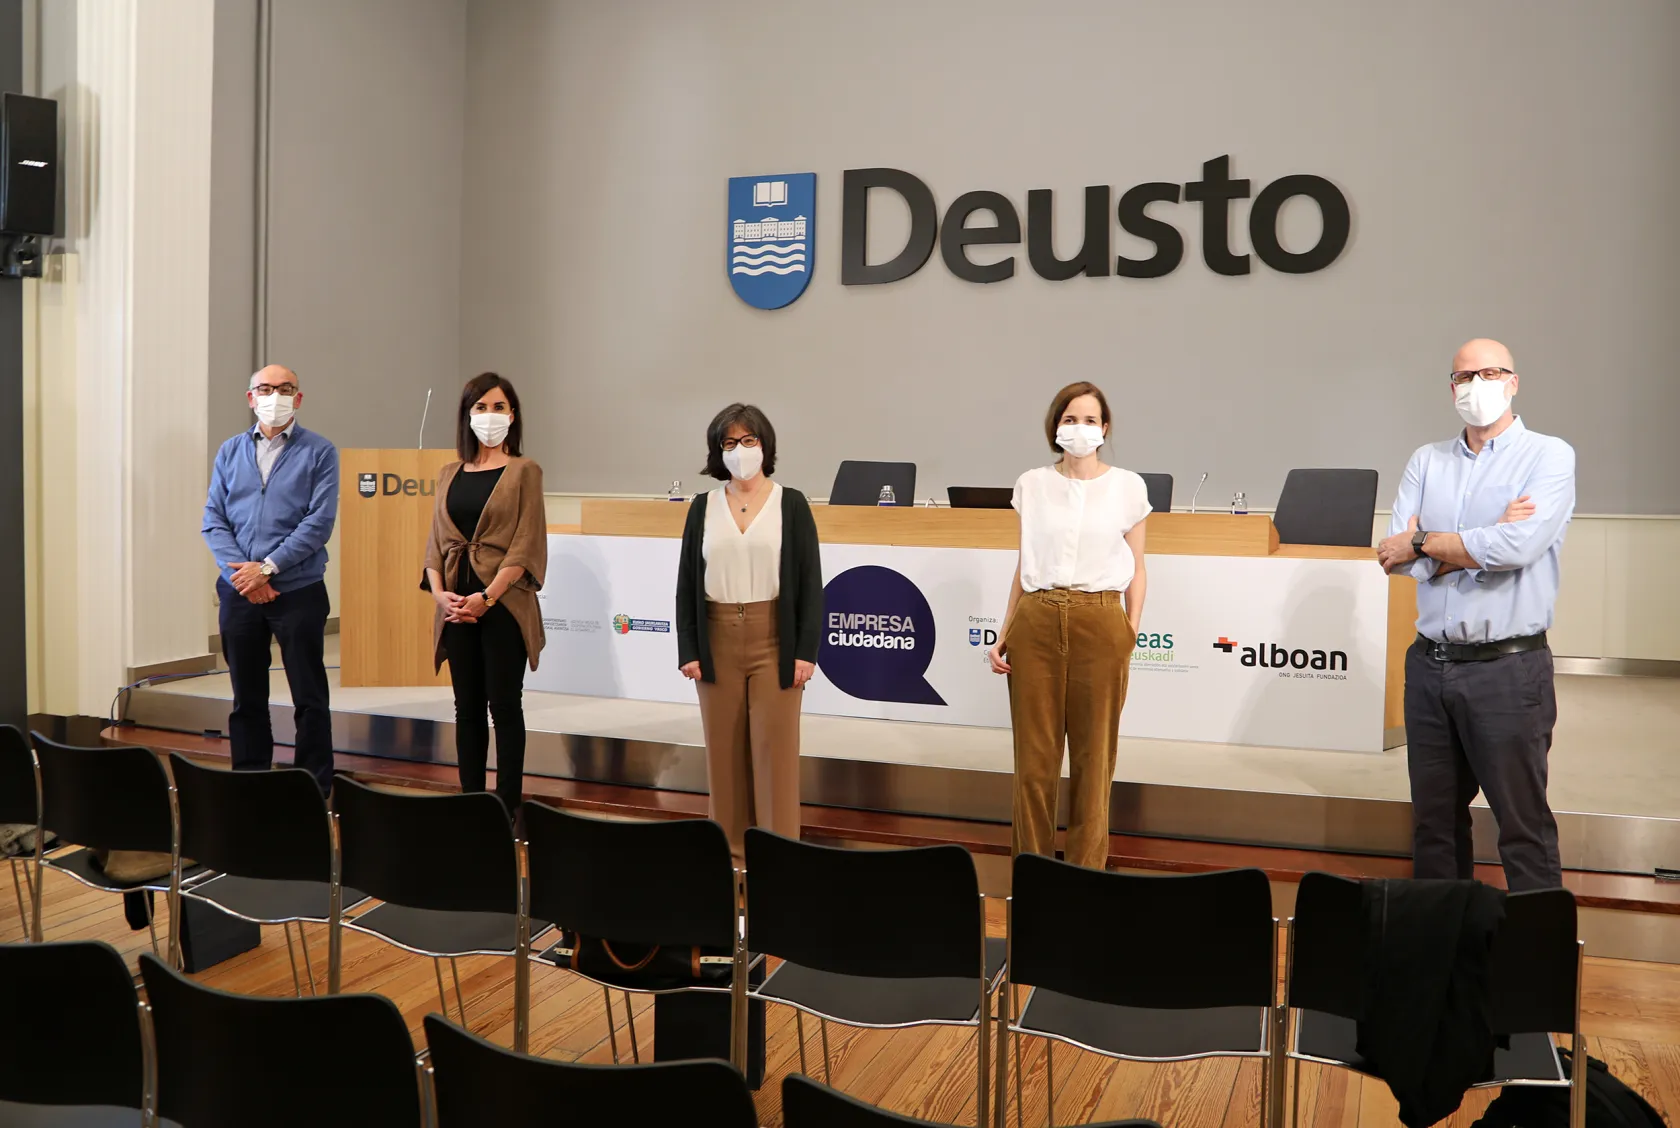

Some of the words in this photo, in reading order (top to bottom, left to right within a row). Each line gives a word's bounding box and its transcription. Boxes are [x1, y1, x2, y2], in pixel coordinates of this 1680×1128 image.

[841, 154, 1351, 286] Deusto
[828, 612, 915, 633] EMPRESA
[828, 630, 915, 650] ciudadana
[1240, 643, 1348, 671] alboan
